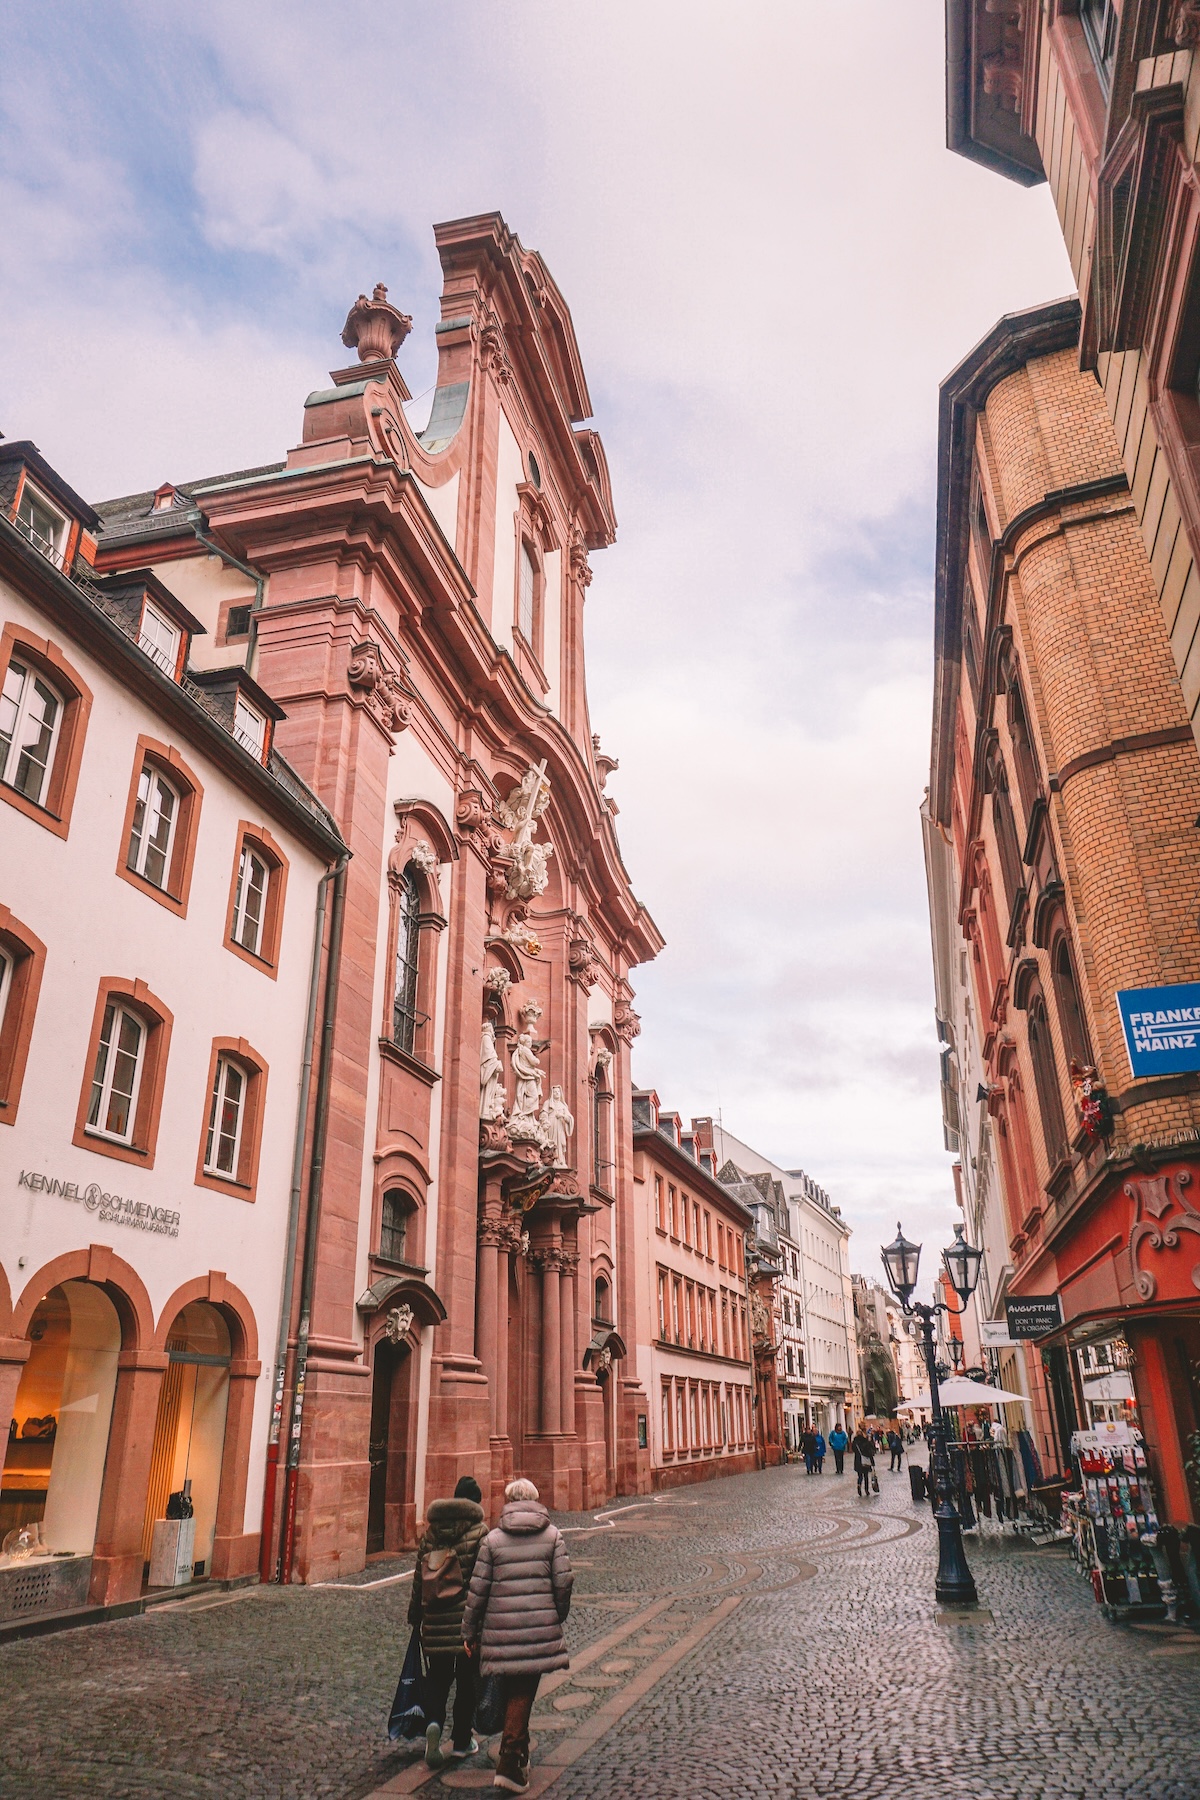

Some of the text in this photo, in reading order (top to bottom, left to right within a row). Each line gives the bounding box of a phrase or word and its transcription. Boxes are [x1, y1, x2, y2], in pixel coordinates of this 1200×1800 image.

[1135, 1035, 1197, 1053] MAINZ
[18, 1170, 181, 1226] KENNEL & SCHMENGER
[99, 1209, 179, 1237] SCHUHMANUFAKTUR
